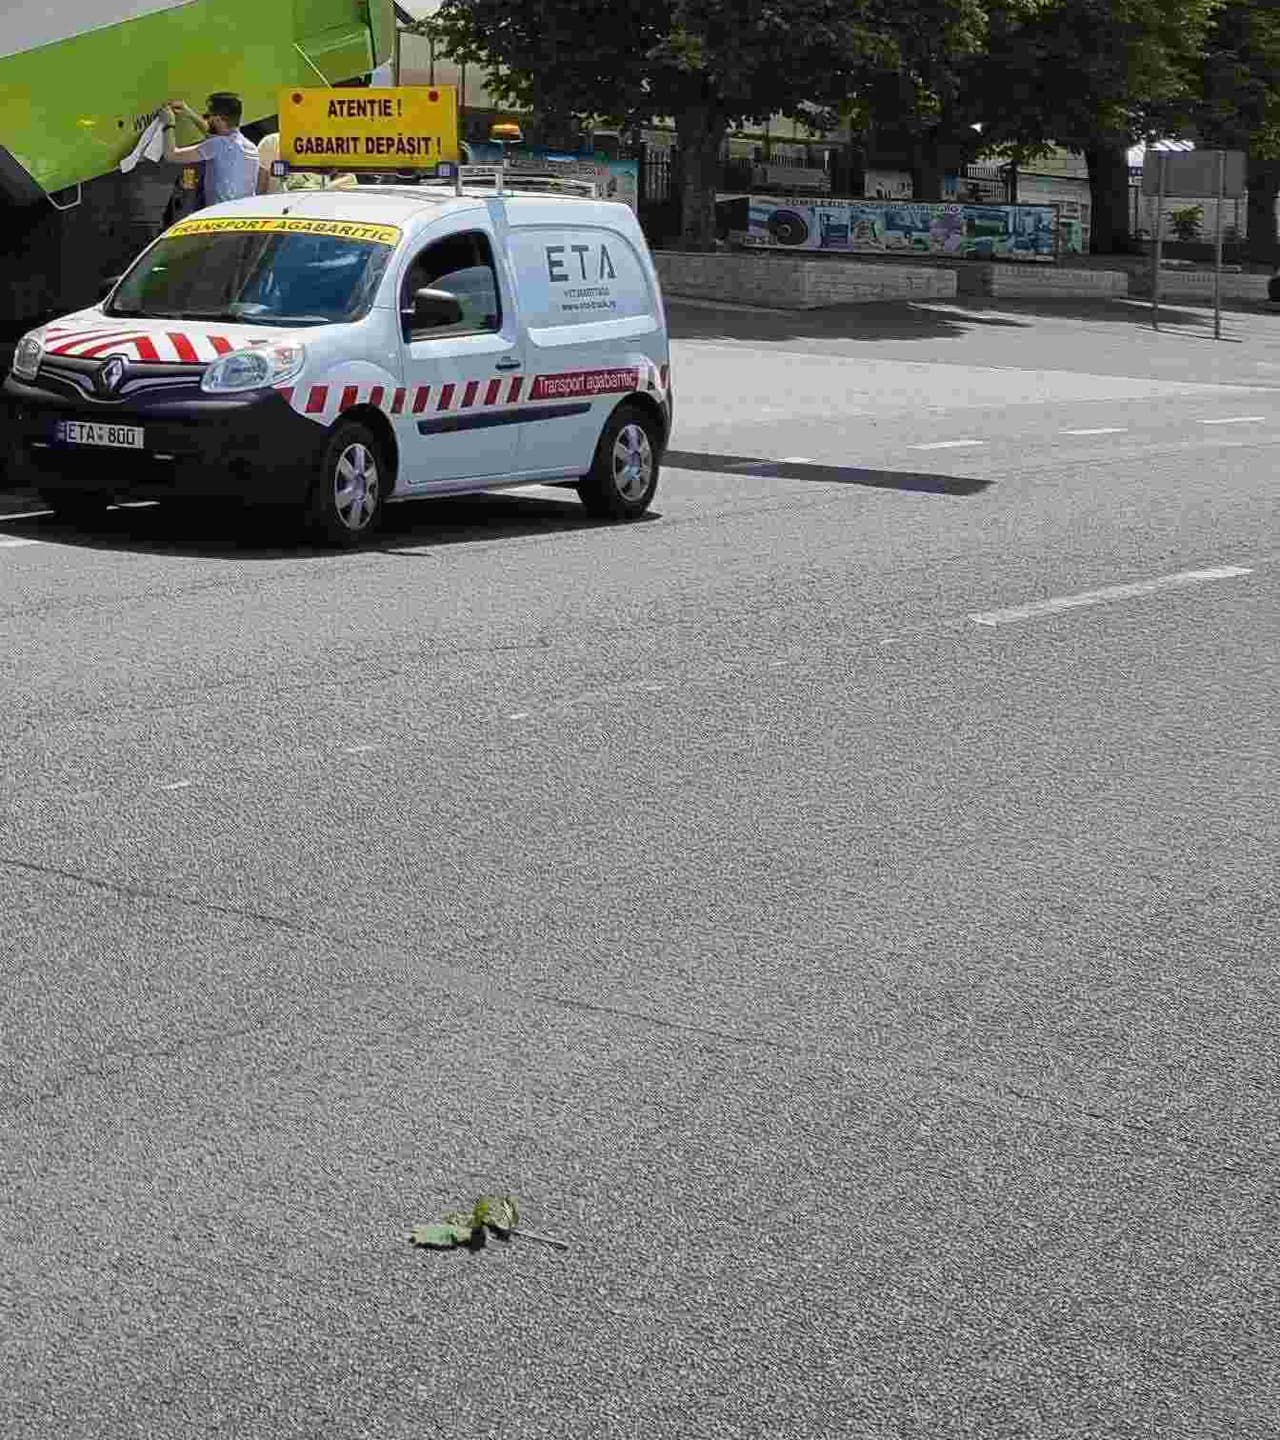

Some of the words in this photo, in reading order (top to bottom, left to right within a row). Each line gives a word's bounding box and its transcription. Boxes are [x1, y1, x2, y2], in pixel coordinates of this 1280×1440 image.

[293, 136, 360, 156] GABARIT
[172, 219, 269, 236] TRANSPORT
[273, 220, 393, 242] AGABARITIC
[545, 235, 617, 282] ETA
[537, 374, 586, 398] Transport
[66, 422, 97, 443] ETA
[107, 426, 137, 445] 800
